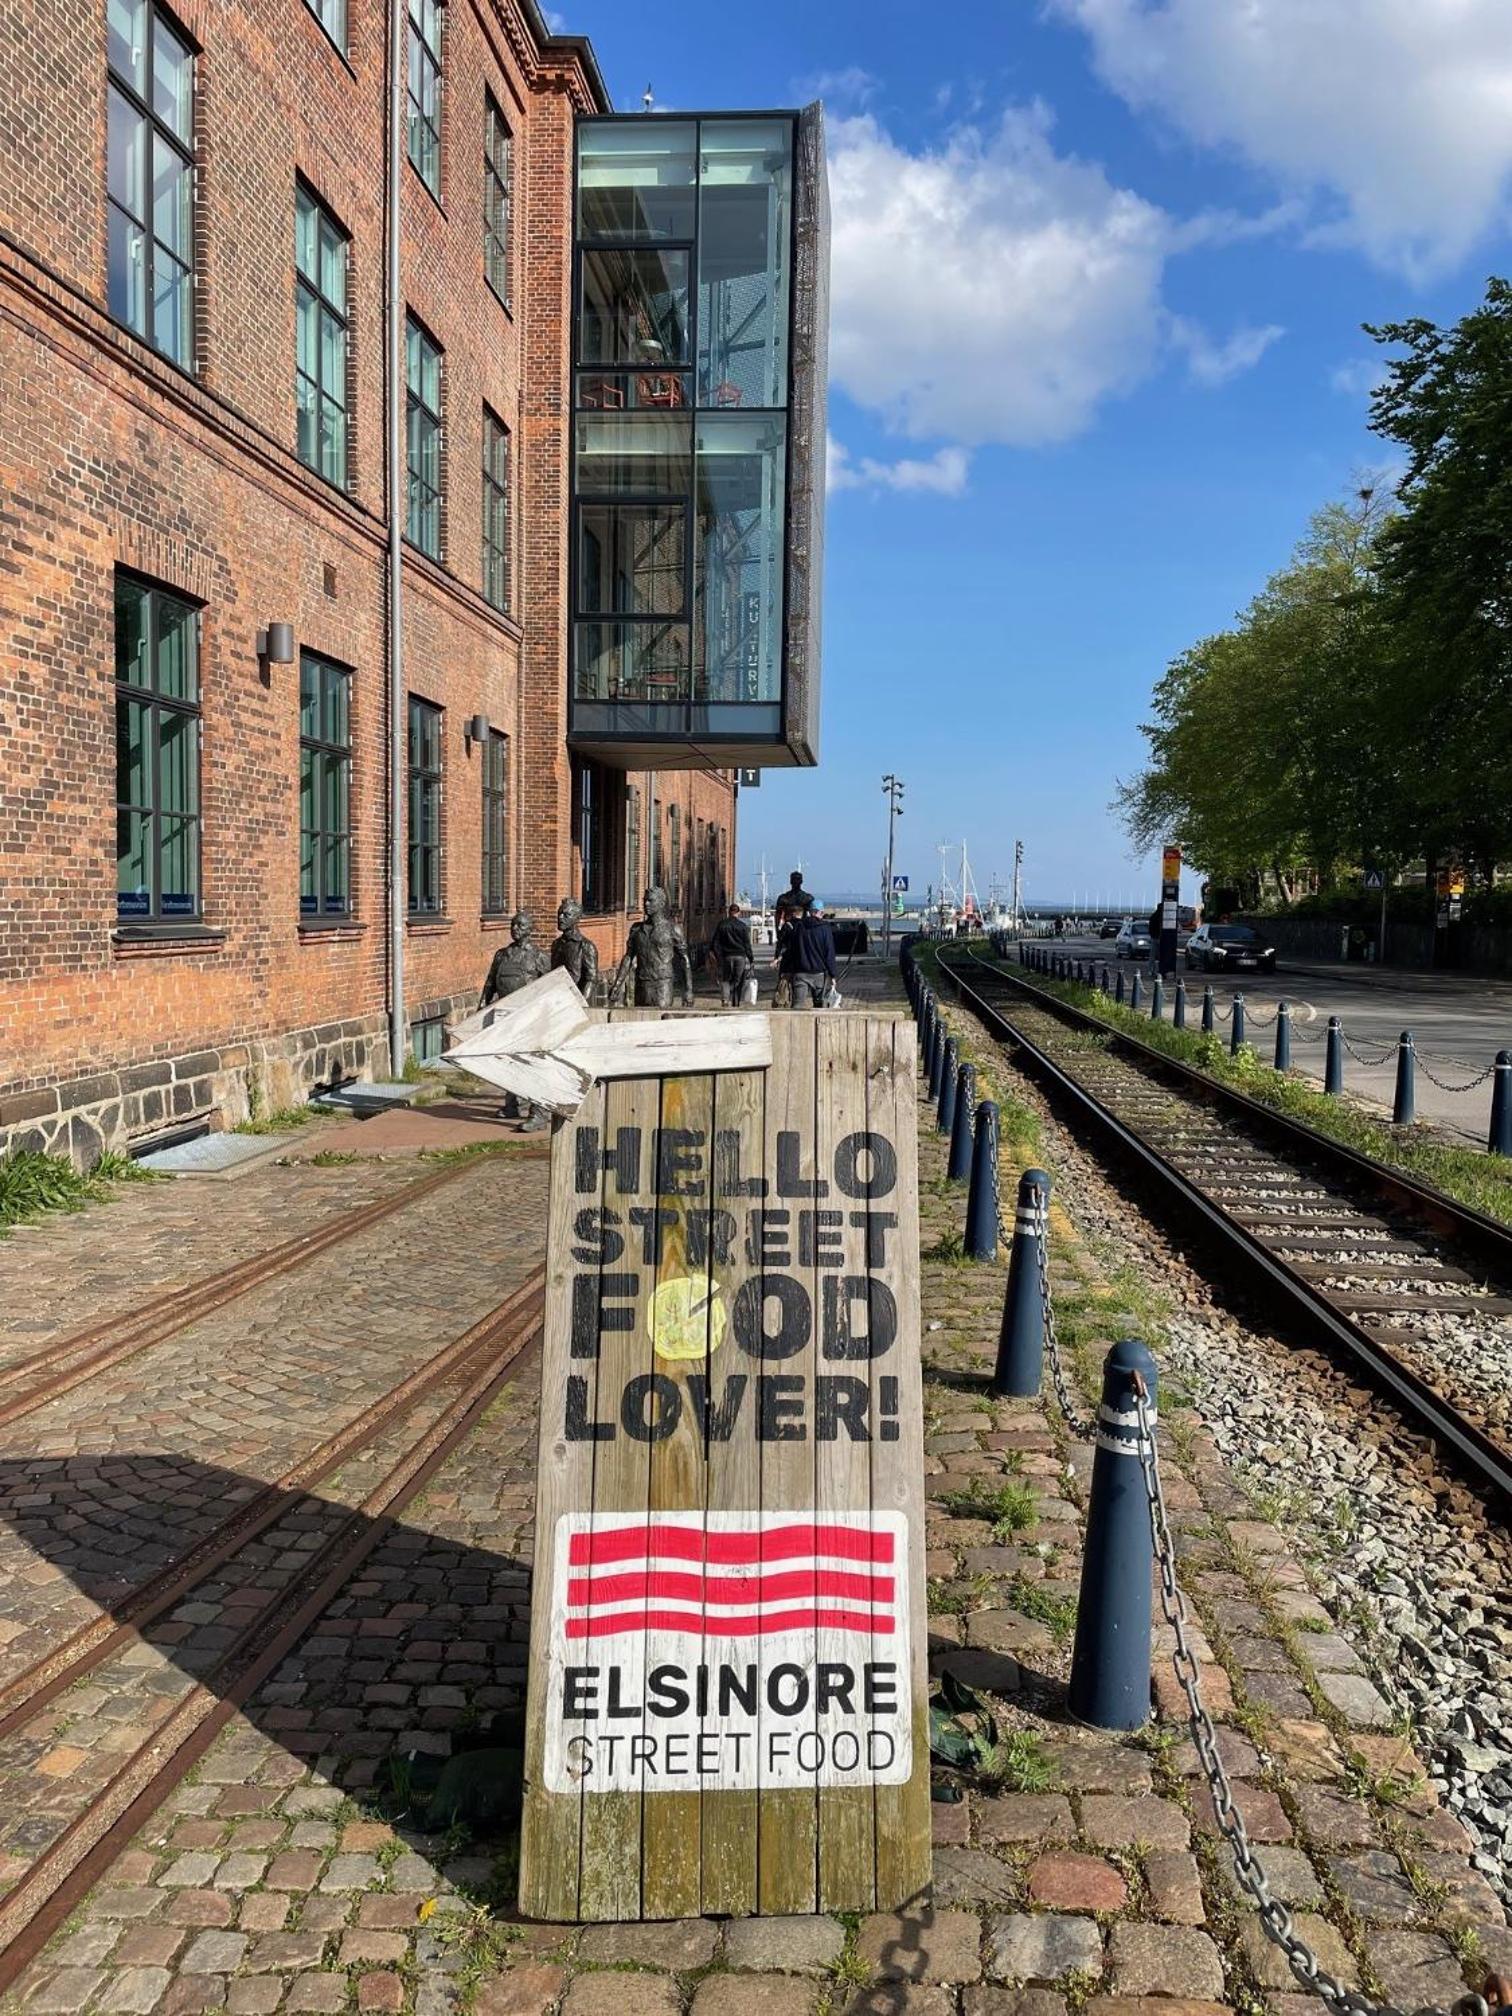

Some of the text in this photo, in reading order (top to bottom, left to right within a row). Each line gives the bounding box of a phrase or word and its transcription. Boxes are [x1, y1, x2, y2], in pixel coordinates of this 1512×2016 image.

[573, 1126, 898, 1200] HELLO
[571, 1206, 899, 1269] STREET
[565, 1373, 900, 1443] LOVER!
[562, 1662, 898, 1720] ELSINORE
[566, 1730, 895, 1777] STREET FOOD
